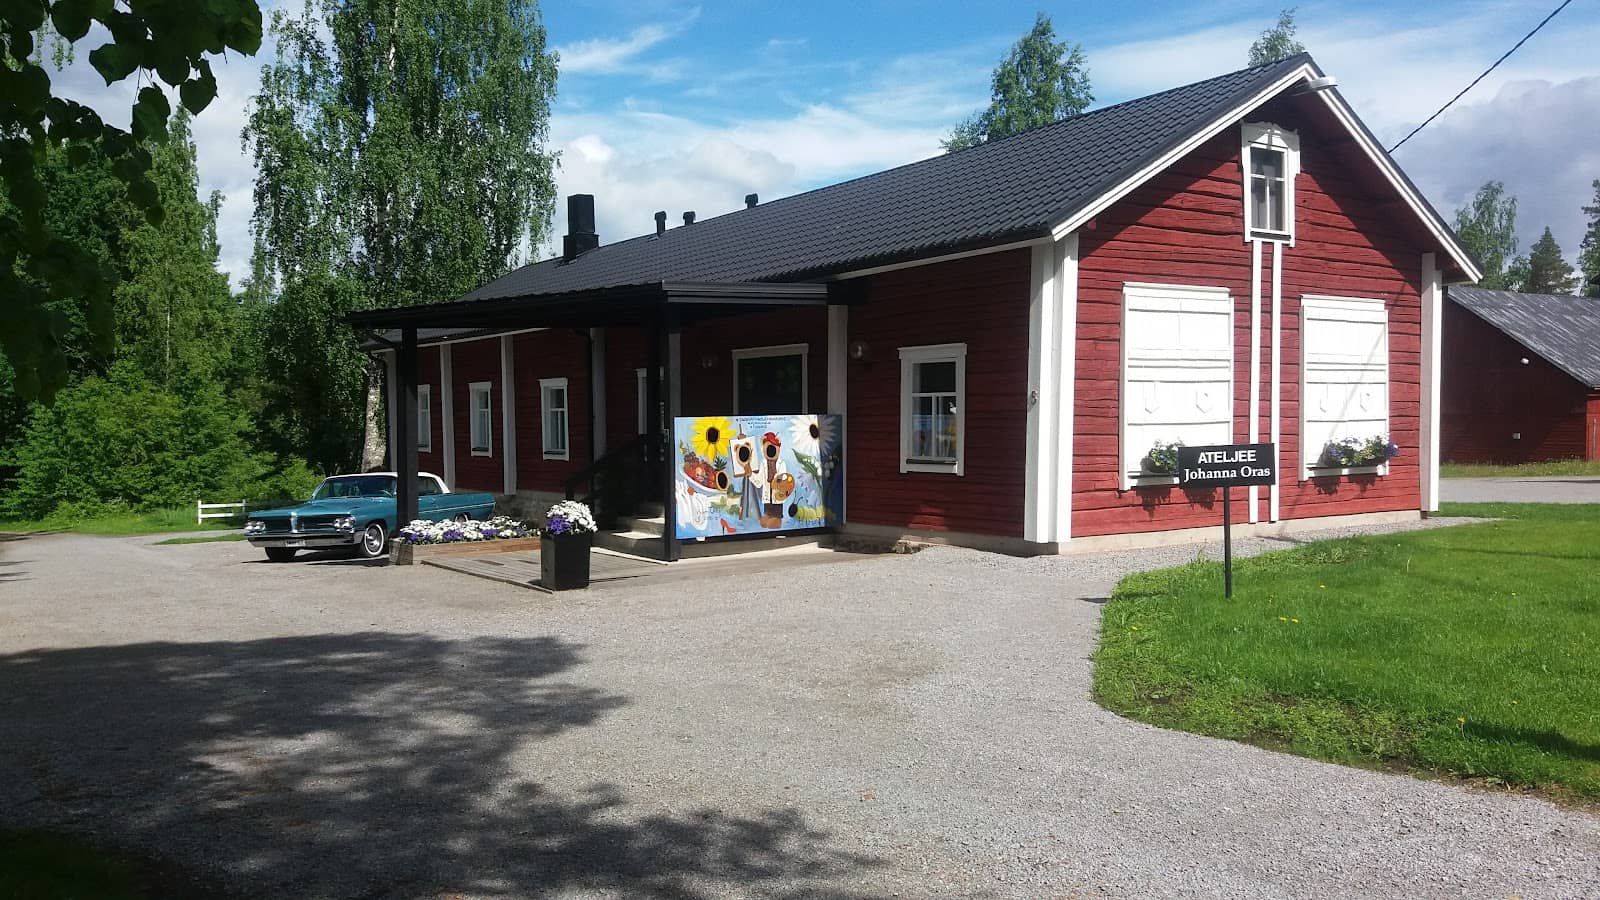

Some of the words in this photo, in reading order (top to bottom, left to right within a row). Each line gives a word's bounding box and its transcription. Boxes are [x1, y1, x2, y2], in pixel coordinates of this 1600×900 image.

[1198, 450, 1257, 464] ATELJEE
[1184, 468, 1237, 482] Johanna
[1240, 466, 1271, 477] Oras
